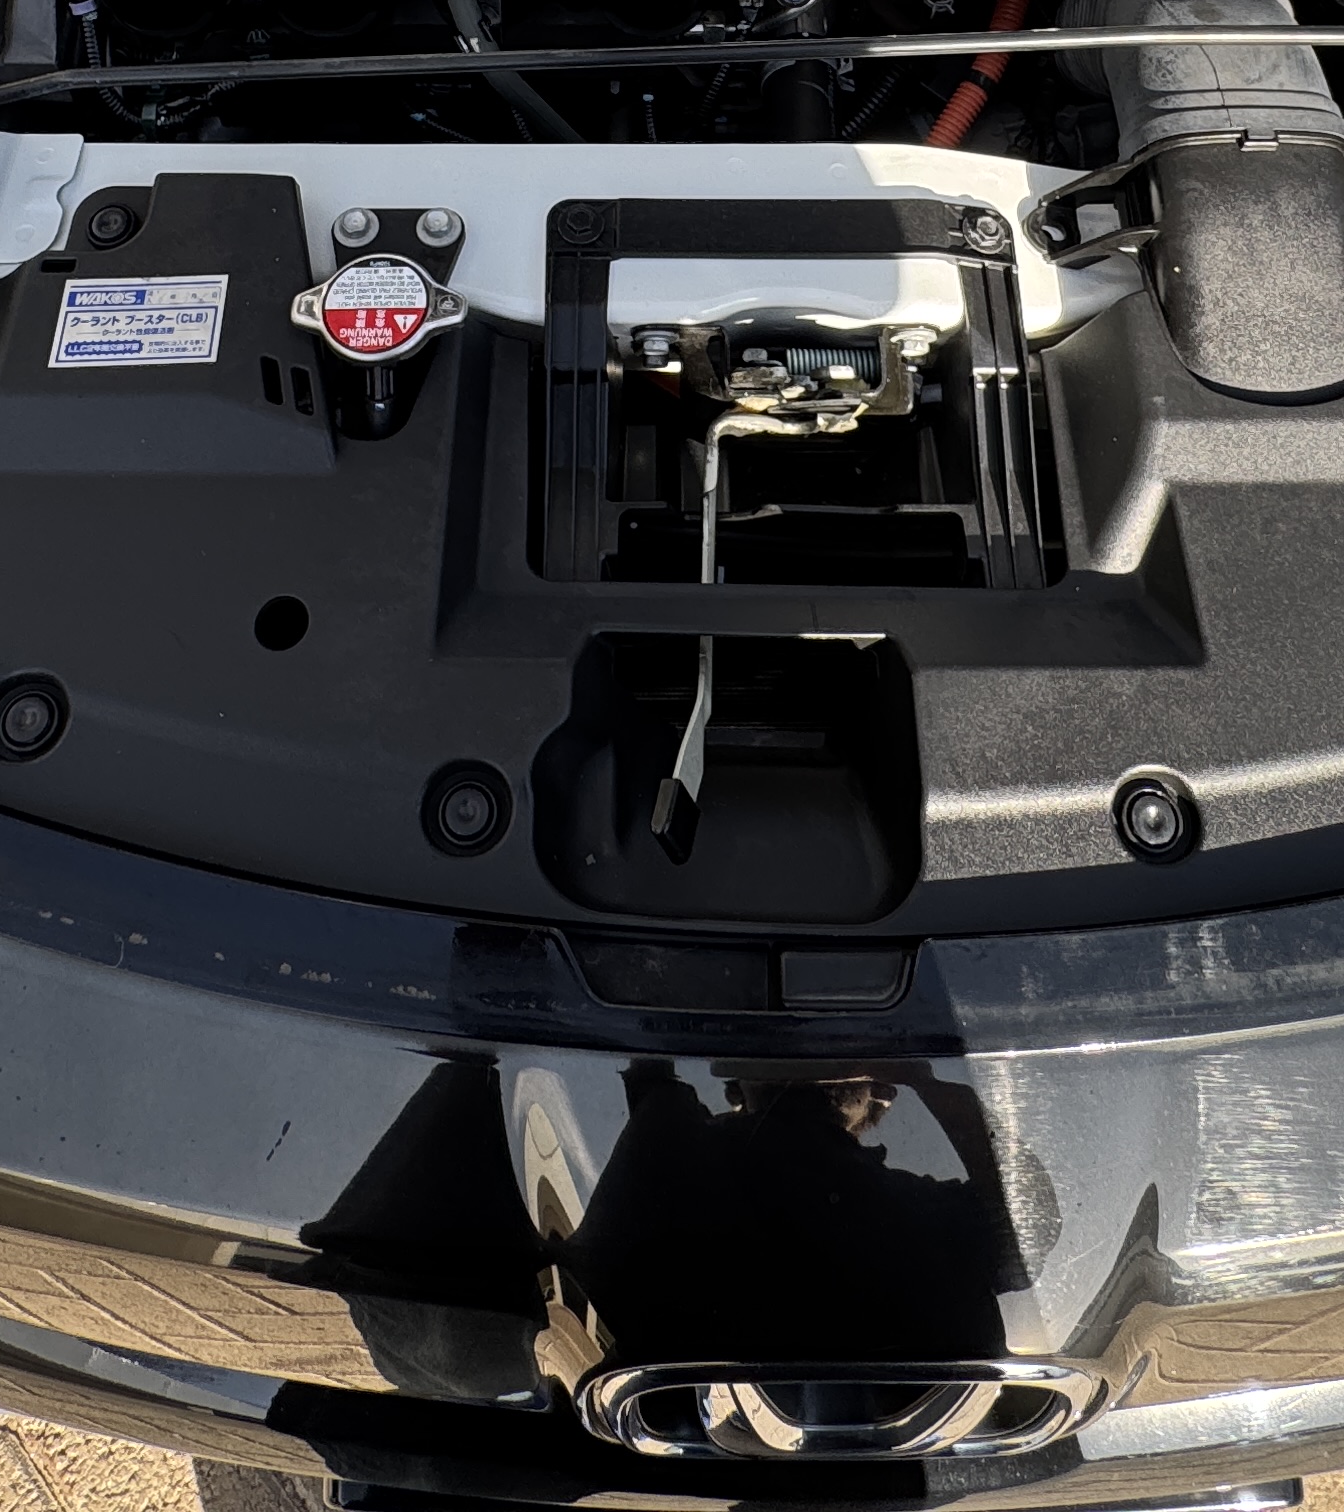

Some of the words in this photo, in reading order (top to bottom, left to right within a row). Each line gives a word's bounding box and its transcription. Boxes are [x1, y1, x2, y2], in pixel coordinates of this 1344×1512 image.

[69, 315, 121, 328] クーラント
[339, 328, 393, 337] WARNUNG
[348, 337, 393, 347] DANGER
